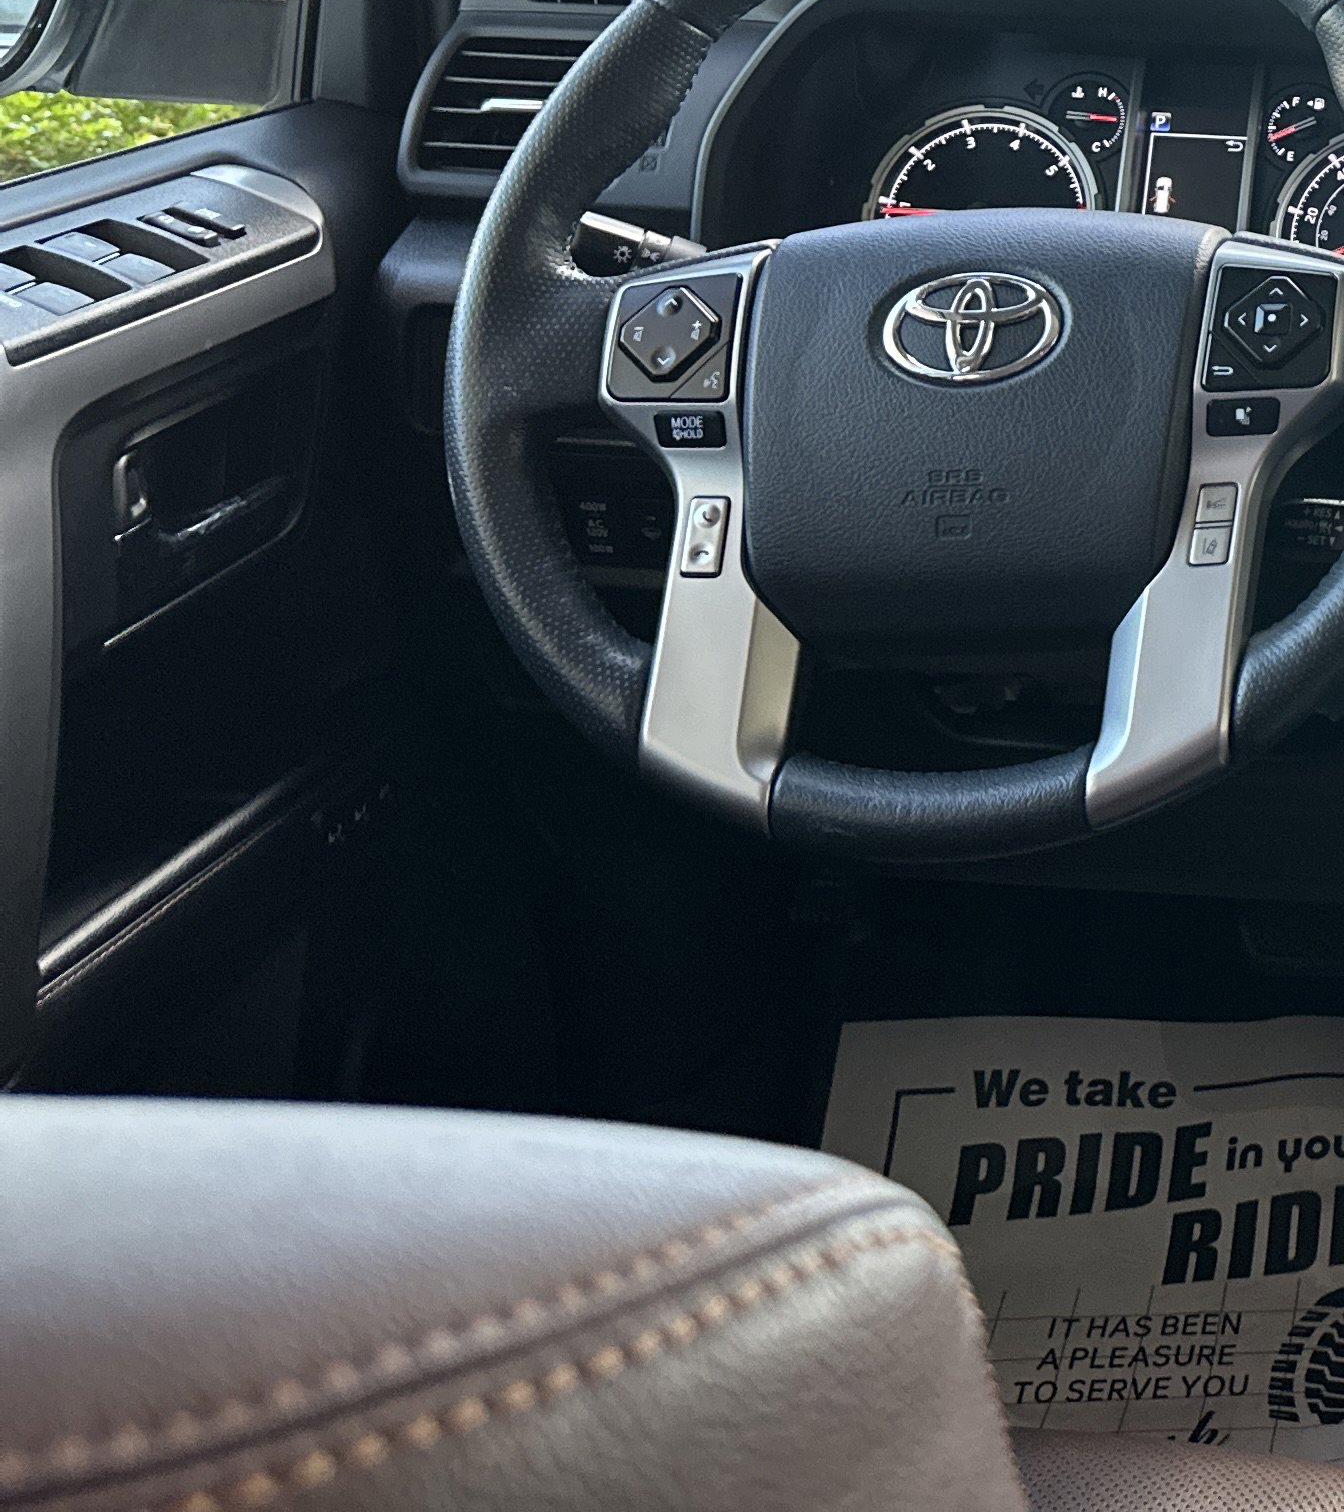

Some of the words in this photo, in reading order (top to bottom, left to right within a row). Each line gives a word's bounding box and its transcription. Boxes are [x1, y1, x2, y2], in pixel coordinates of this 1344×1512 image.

[1098, 87, 1108, 97] H
[1291, 96, 1301, 107] F
[965, 136, 977, 150] 3
[1009, 138, 1021, 151] 4
[1091, 141, 1102, 153] C
[1286, 150, 1295, 162] E
[922, 158, 936, 172] 2
[1045, 164, 1059, 177] 5
[1304, 206, 1319, 224] 20
[671, 416, 704, 429] MODE
[682, 429, 704, 439] HOLD
[901, 488, 1011, 506] AIRBAG
[973, 1070, 1048, 1109] We
[1064, 1070, 1177, 1109] take
[948, 1122, 1213, 1226] PRIDE
[1226, 1136, 1263, 1171] in
[1048, 1317, 1080, 1340] IT
[1088, 1316, 1152, 1339] HAS
[1160, 1313, 1242, 1337] BEEN
[1037, 1348, 1062, 1370] A
[1068, 1344, 1236, 1369] PLEASURE
[1013, 1380, 1057, 1405] TO
[1064, 1376, 1170, 1404] SERVE
[1181, 1375, 1250, 1400] YOU
